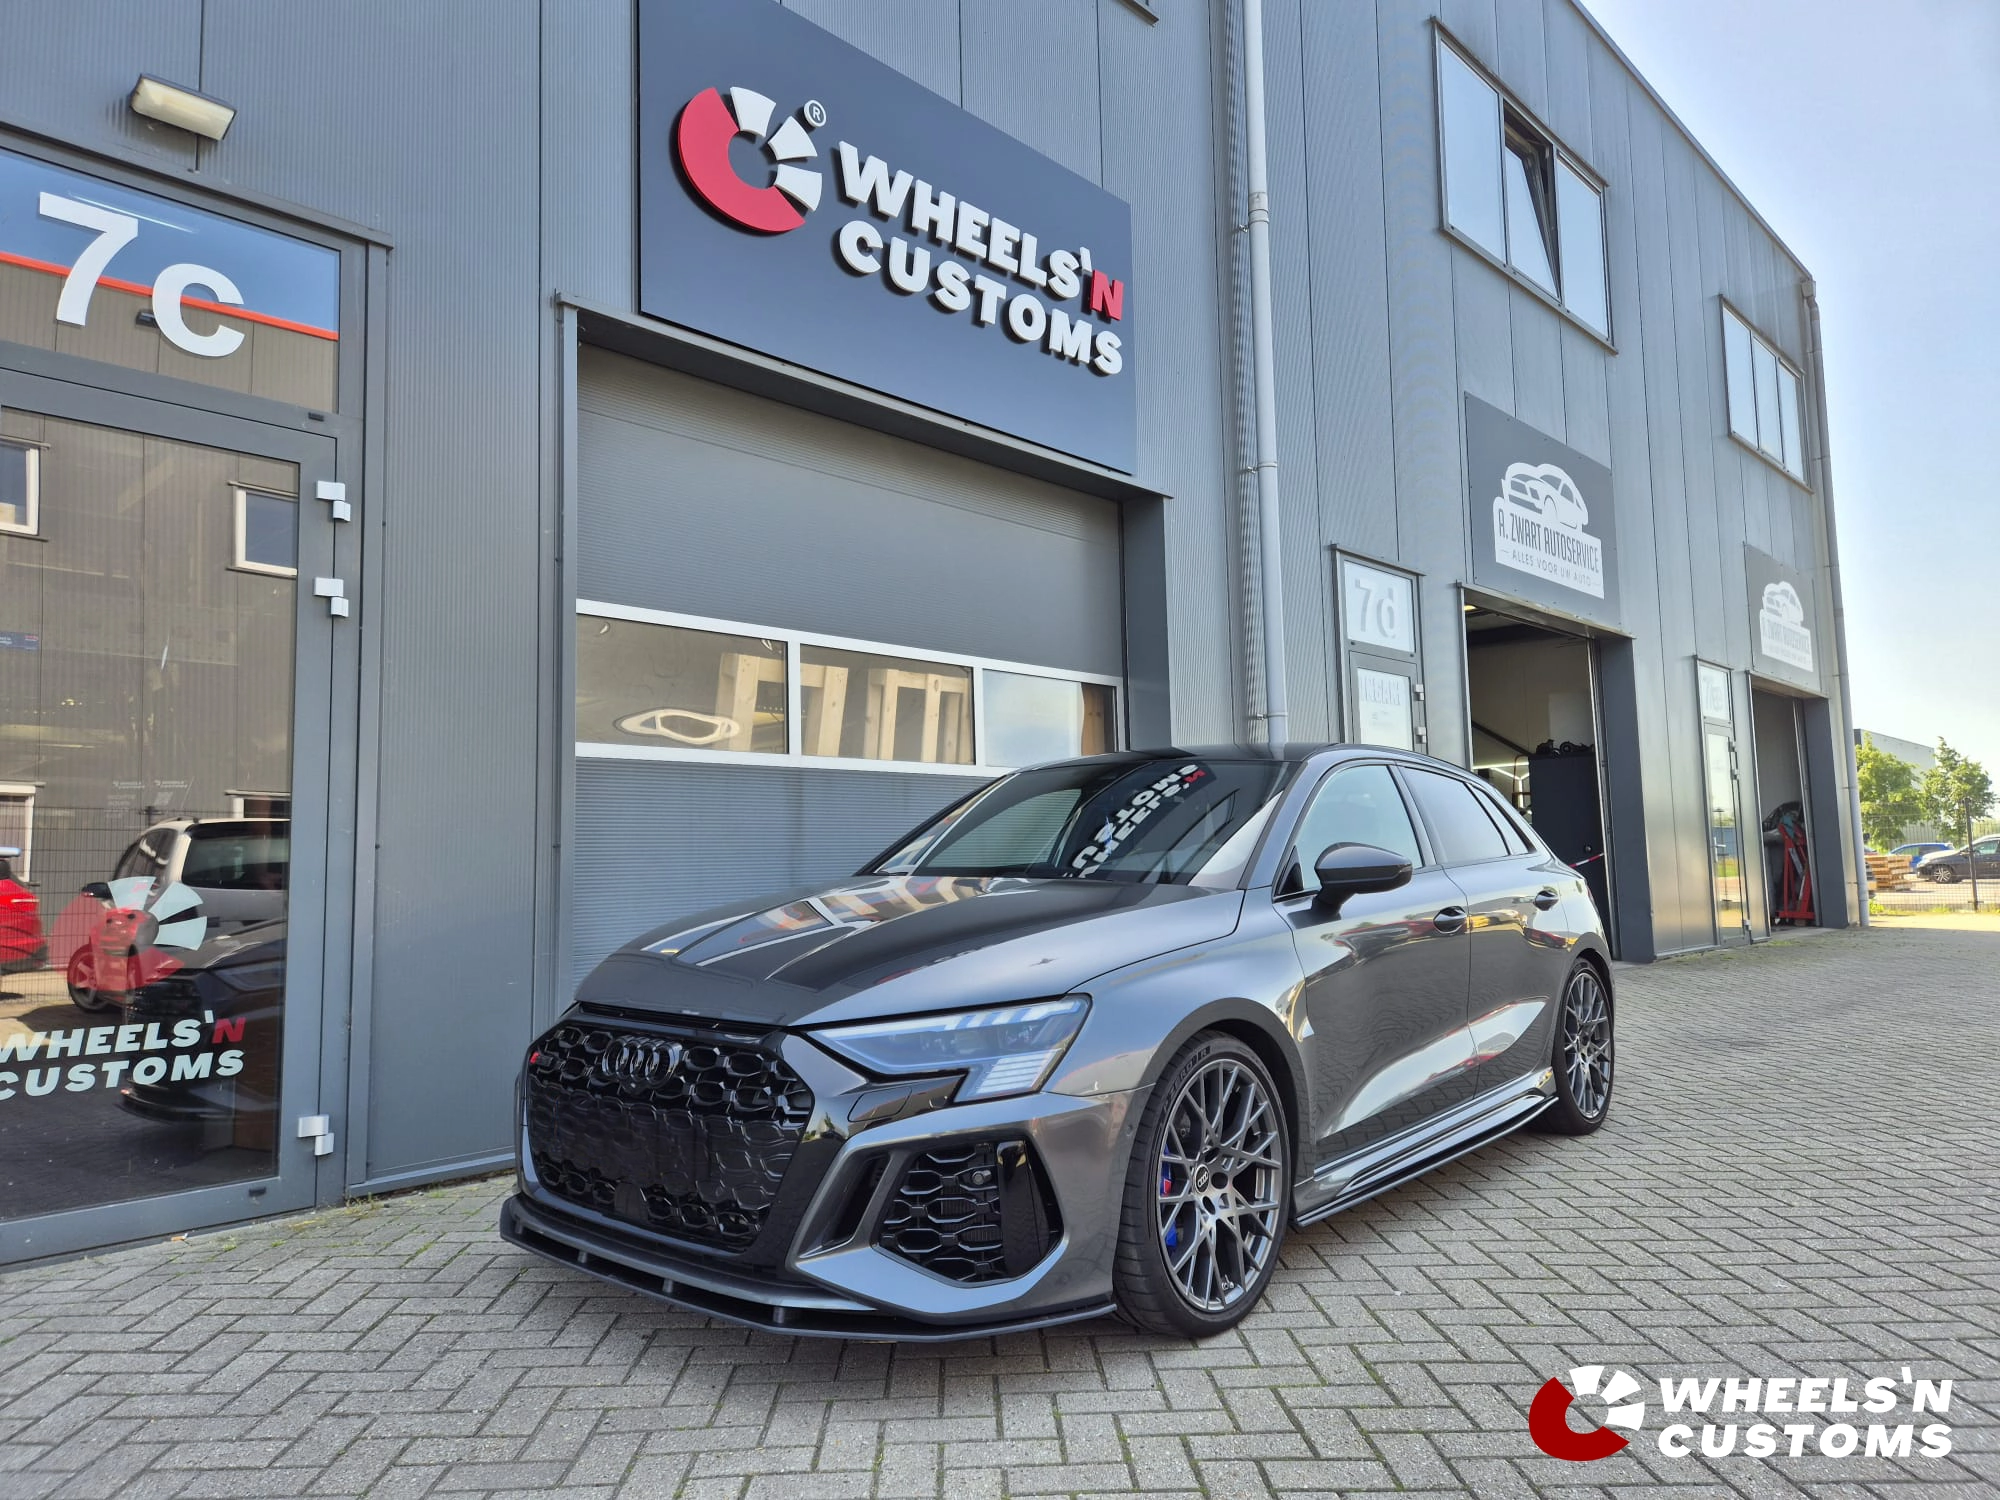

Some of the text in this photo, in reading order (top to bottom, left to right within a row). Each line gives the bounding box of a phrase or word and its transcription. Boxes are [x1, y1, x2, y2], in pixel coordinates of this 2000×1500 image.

[838, 140, 1124, 321] WHEELS'N
[838, 220, 1123, 375] CUSTOMS
[1510, 512, 1541, 551] ZWART
[1543, 526, 1599, 573] AUTOSERVICE
[1537, 556, 1558, 575] VOOR
